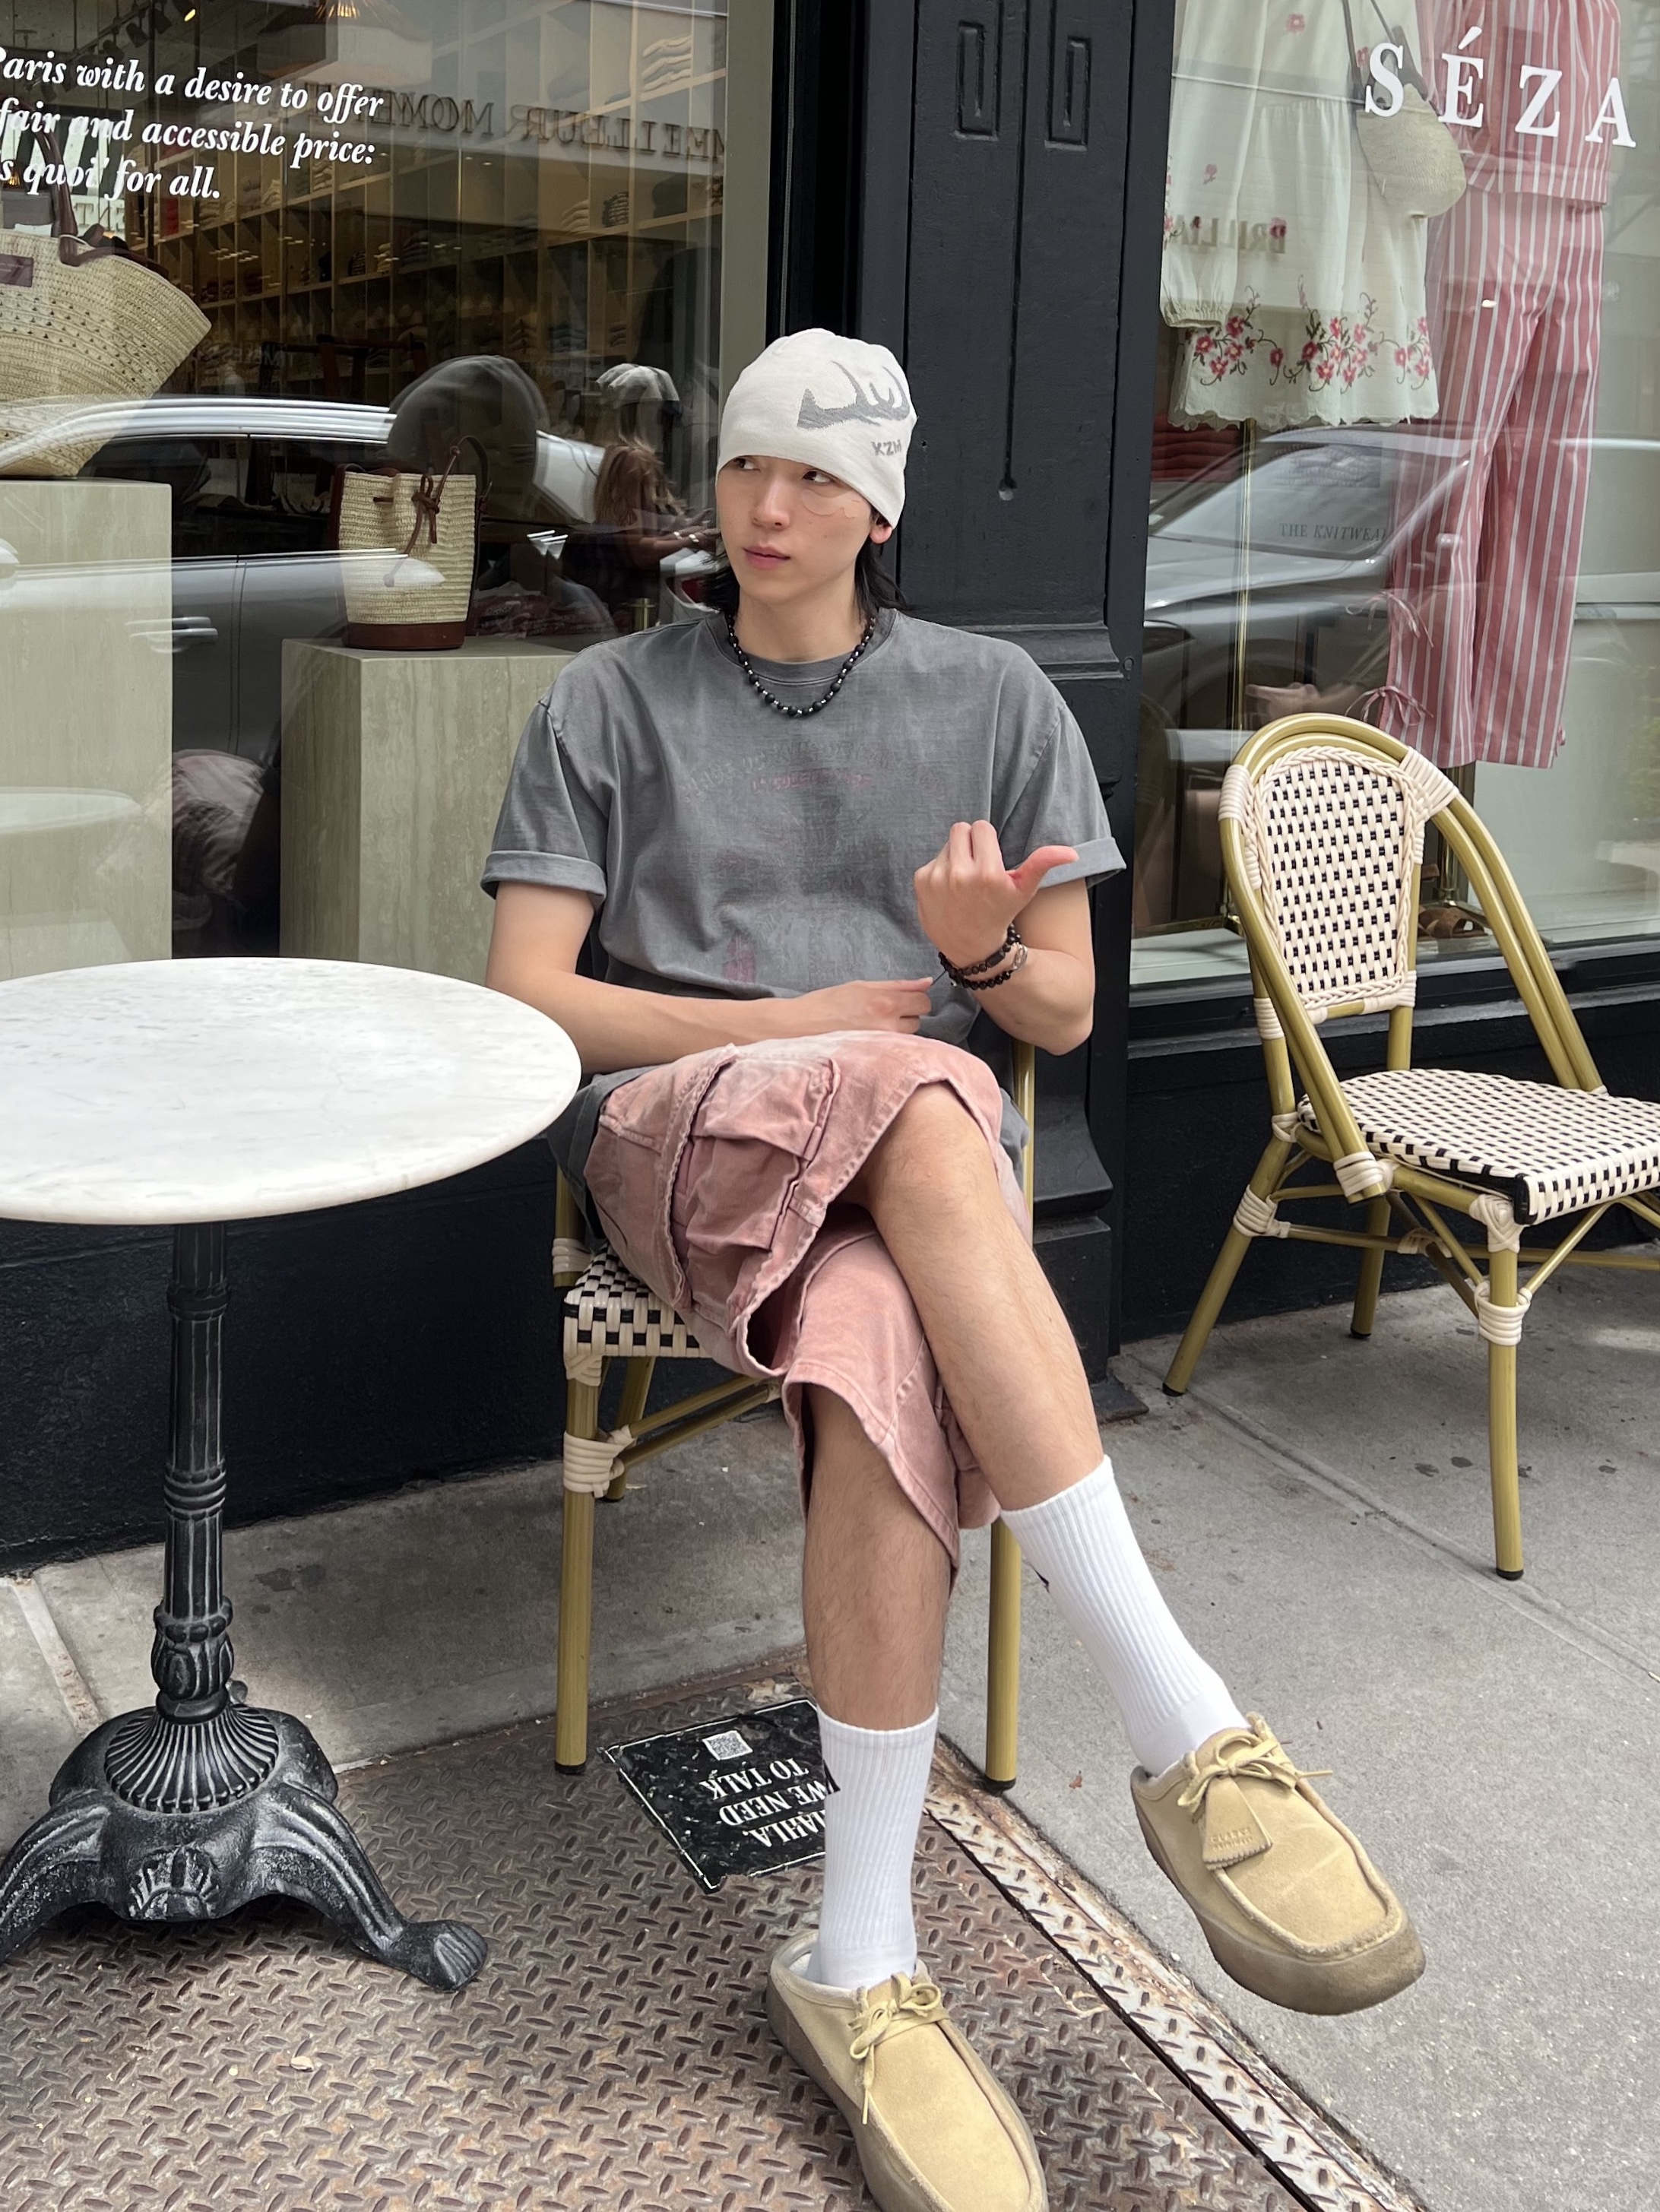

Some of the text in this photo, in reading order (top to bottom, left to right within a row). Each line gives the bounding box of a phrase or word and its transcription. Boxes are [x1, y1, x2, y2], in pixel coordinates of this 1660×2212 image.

[77, 57, 145, 92] with
[154, 74, 175, 95] a
[185, 67, 272, 105] desire
[280, 84, 308, 109] to
[317, 84, 384, 123] offer
[0, 97, 375, 169] fair and accessible price:
[104, 159, 161, 201] for
[169, 165, 220, 199] all.
[1279, 522, 1308, 537] THE
[699, 1757, 809, 1801] TO TALK
[719, 1779, 835, 1826] WE NEED
